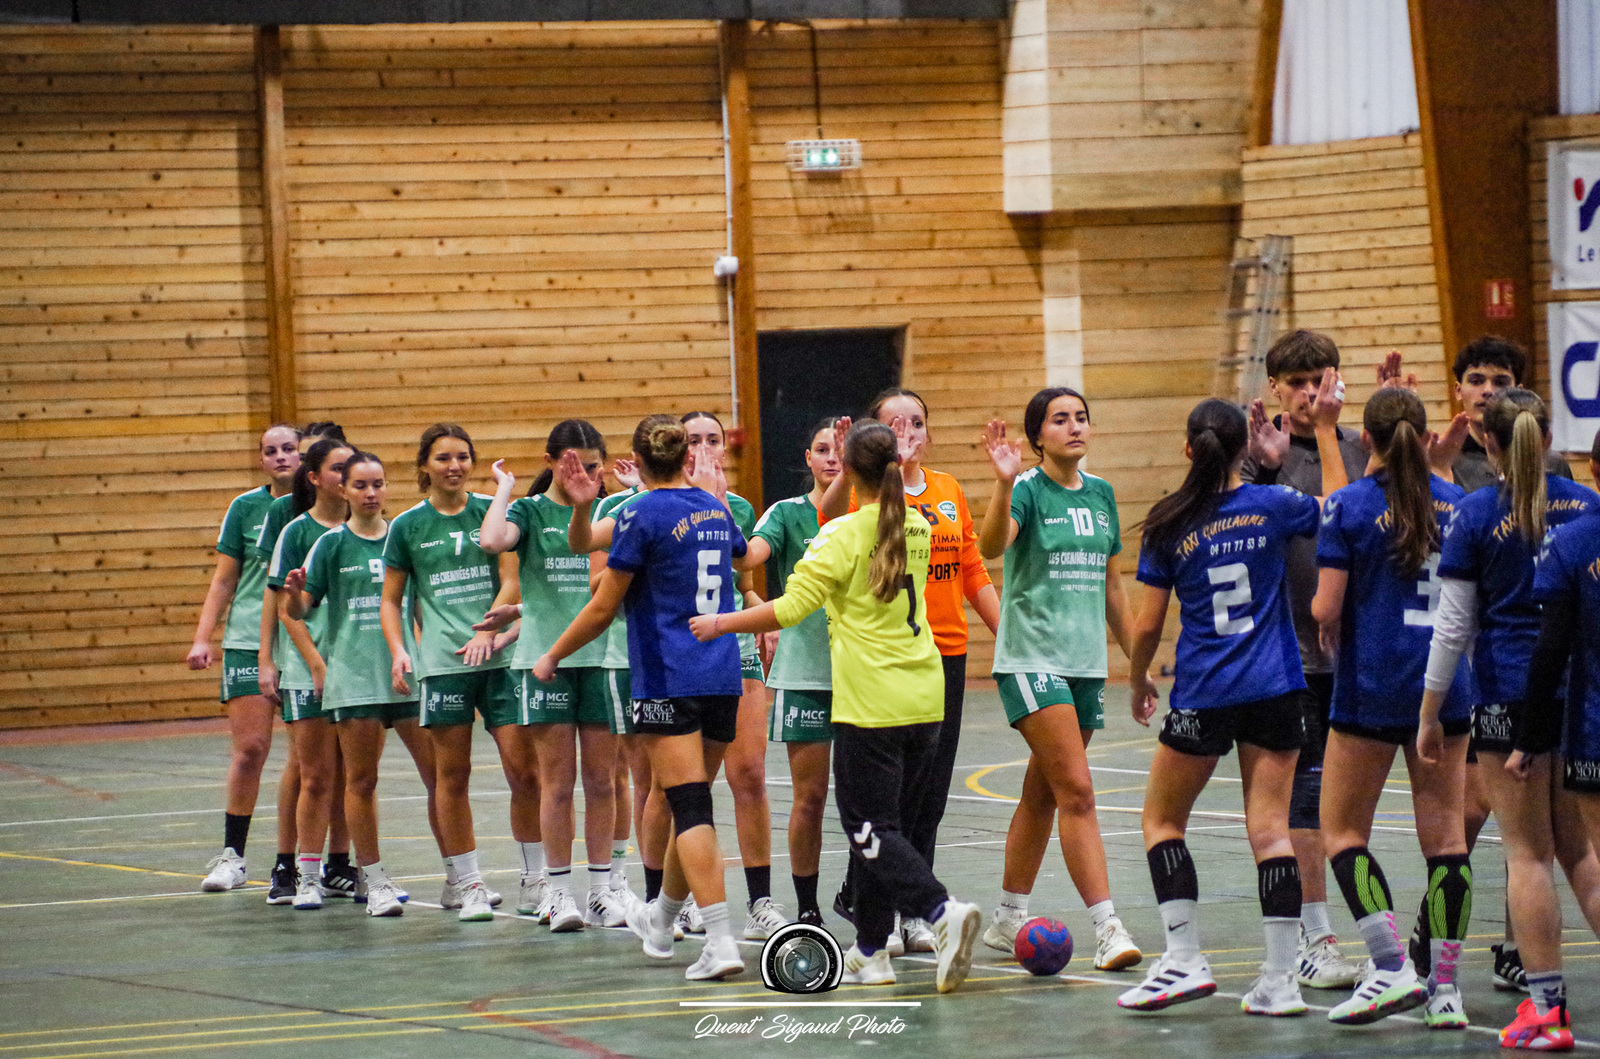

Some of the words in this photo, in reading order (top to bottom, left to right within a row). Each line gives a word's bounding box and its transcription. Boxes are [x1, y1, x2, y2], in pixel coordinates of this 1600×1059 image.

[1577, 245, 1595, 263] Le
[1545, 499, 1588, 512] LAUME
[1067, 508, 1094, 536] 10
[671, 517, 690, 542] TAXI
[903, 526, 929, 538] LAUME
[420, 540, 440, 549] CRAFT
[448, 531, 463, 556] 7
[1176, 531, 1200, 560] TAXI
[1202, 515, 1268, 541] GUILLAUME
[1210, 543, 1220, 556] 04
[1222, 541, 1231, 554] 71
[1234, 539, 1244, 552] 77
[544, 557, 554, 569] LES
[368, 558, 385, 584] 9
[429, 573, 440, 586] LES
[695, 549, 723, 615] 6
[1403, 552, 1442, 627] 3
[1207, 562, 1255, 636] 2
[237, 667, 258, 676] MCC
[442, 694, 464, 704] MCC
[546, 692, 569, 702] MCC
[643, 703, 675, 713] BERGA
[801, 709, 825, 720] MCC
[644, 711, 672, 721] MOTE
[1171, 712, 1200, 729] BERGA
[1480, 714, 1513, 728] BERGA
